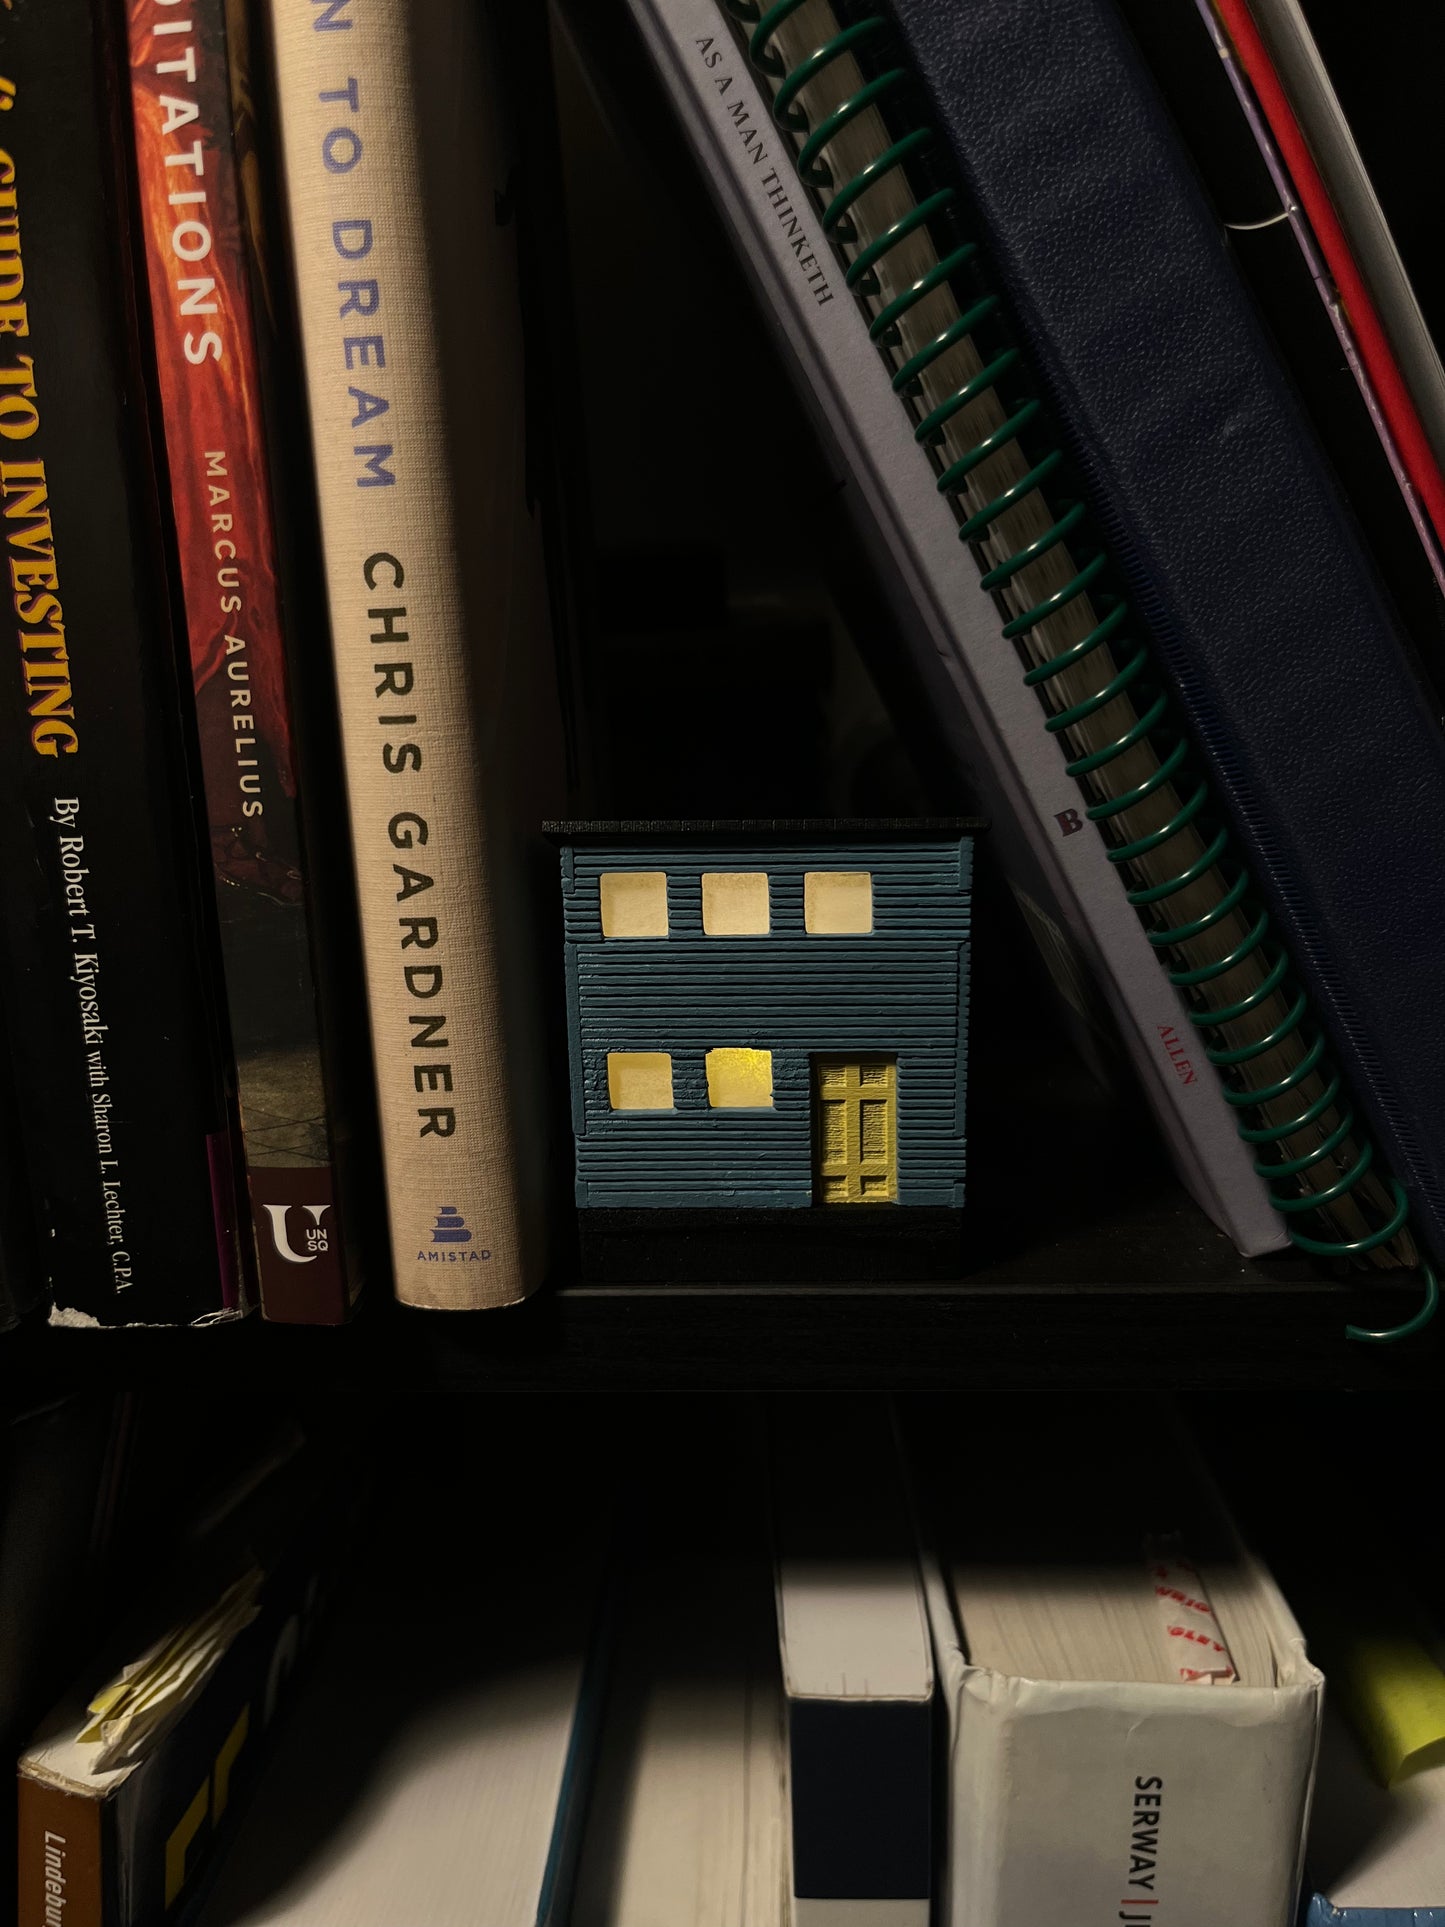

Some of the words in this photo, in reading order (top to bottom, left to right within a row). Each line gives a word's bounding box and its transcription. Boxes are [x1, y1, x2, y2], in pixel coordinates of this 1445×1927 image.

[318, 77, 363, 175] TO
[153, 0, 223, 365] ITATIONS
[696, 37, 722, 70] AS
[714, 76, 733, 96] A
[727, 100, 769, 165] MAN
[760, 167, 835, 307] THINKETH
[332, 219, 397, 488] DREAM
[0, 353, 40, 440] TO
[0, 456, 79, 758] INVESTING
[204, 450, 242, 613] MARCUS
[224, 634, 264, 818] AURELIUS
[363, 551, 422, 774] CHRIS
[48, 796, 81, 828] By
[59, 834, 91, 917] Robert
[70, 923, 97, 944] T.
[387, 811, 457, 1139] GARDNER
[69, 951, 110, 1045] Kiyosaki
[85, 1050, 110, 1088] with
[1156, 1023, 1199, 1087] ALLEN
[92, 1093, 113, 1154] Sharon
[102, 1180, 126, 1246] Lechter,
[306, 1228, 328, 1240] UN
[307, 1240, 329, 1252] SQ
[111, 1251, 133, 1295] C.P.A.
[417, 1249, 491, 1262] AMISTAD
[1128, 1776, 1163, 1891] SERWAY
[1119, 1910, 1152, 1927] J
